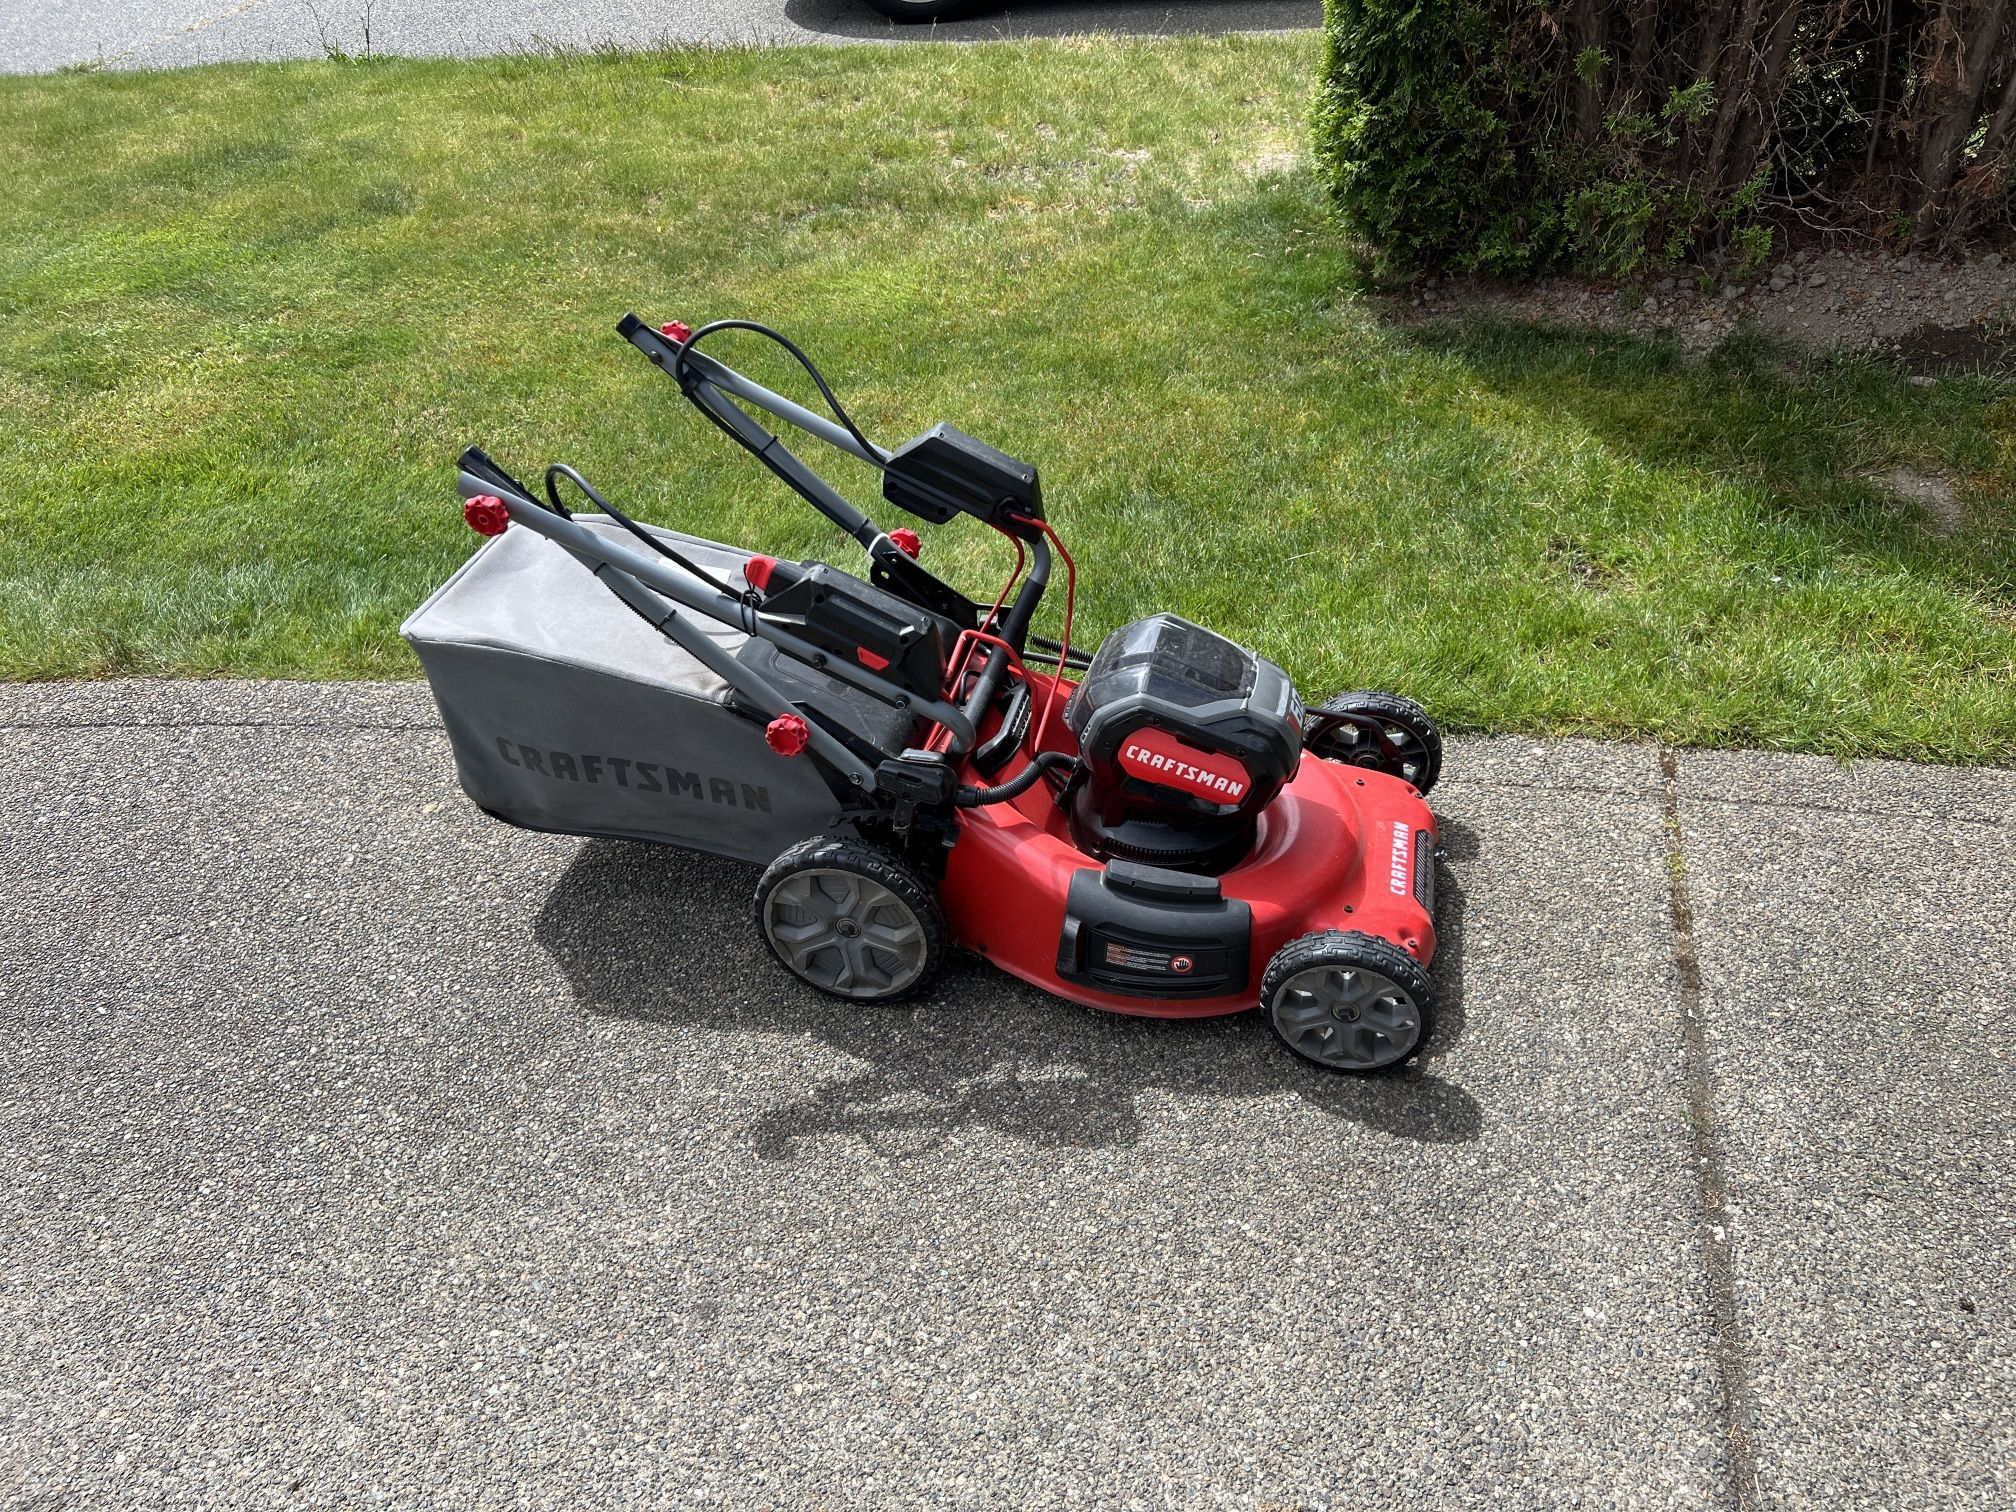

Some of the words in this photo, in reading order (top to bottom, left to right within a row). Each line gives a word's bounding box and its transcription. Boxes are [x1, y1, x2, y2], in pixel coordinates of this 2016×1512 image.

[496, 736, 772, 814] CRAFTSMAN
[1126, 744, 1244, 797] CRAFTSMAN
[1390, 821, 1409, 896] CRAFTSMAN
